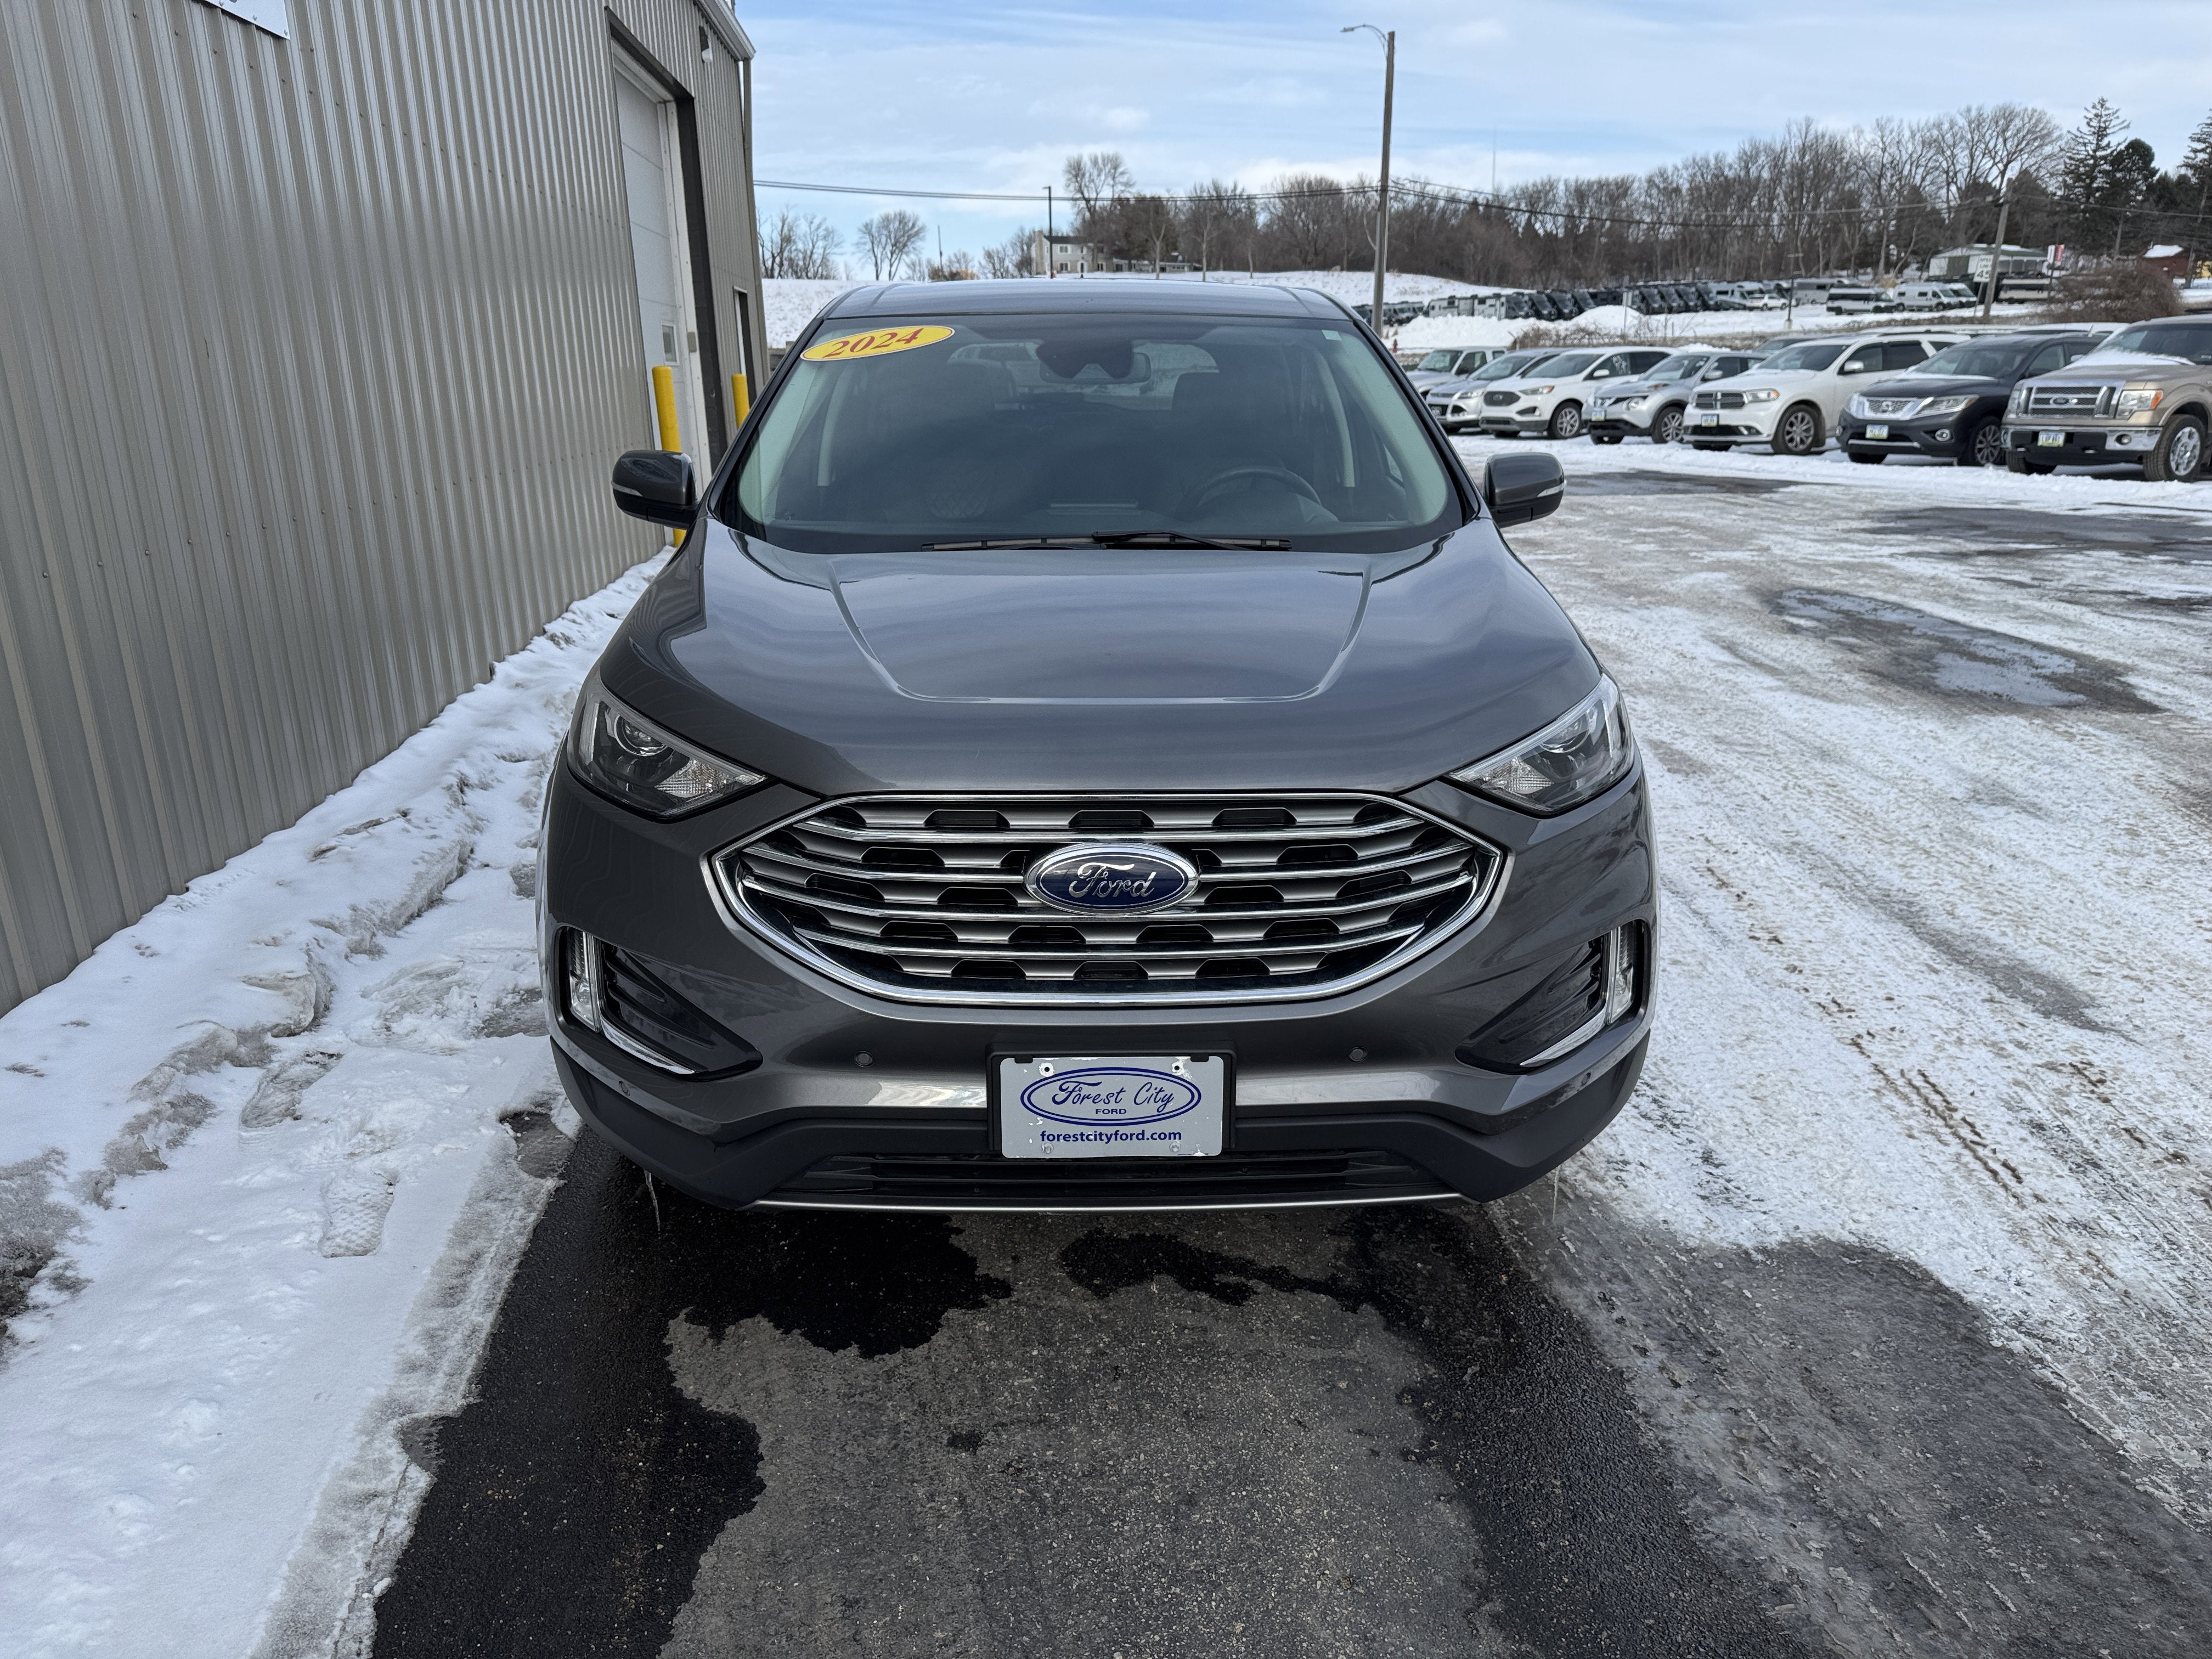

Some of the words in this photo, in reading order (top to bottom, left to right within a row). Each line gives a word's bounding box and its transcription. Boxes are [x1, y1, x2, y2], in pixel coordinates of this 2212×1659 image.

[822, 328, 924, 358] 2024
[1069, 862, 1156, 898] Ford
[1052, 1081, 1126, 1105] Forest
[1133, 1082, 1174, 1113] City
[1040, 1130, 1182, 1144] forestcityford.com
